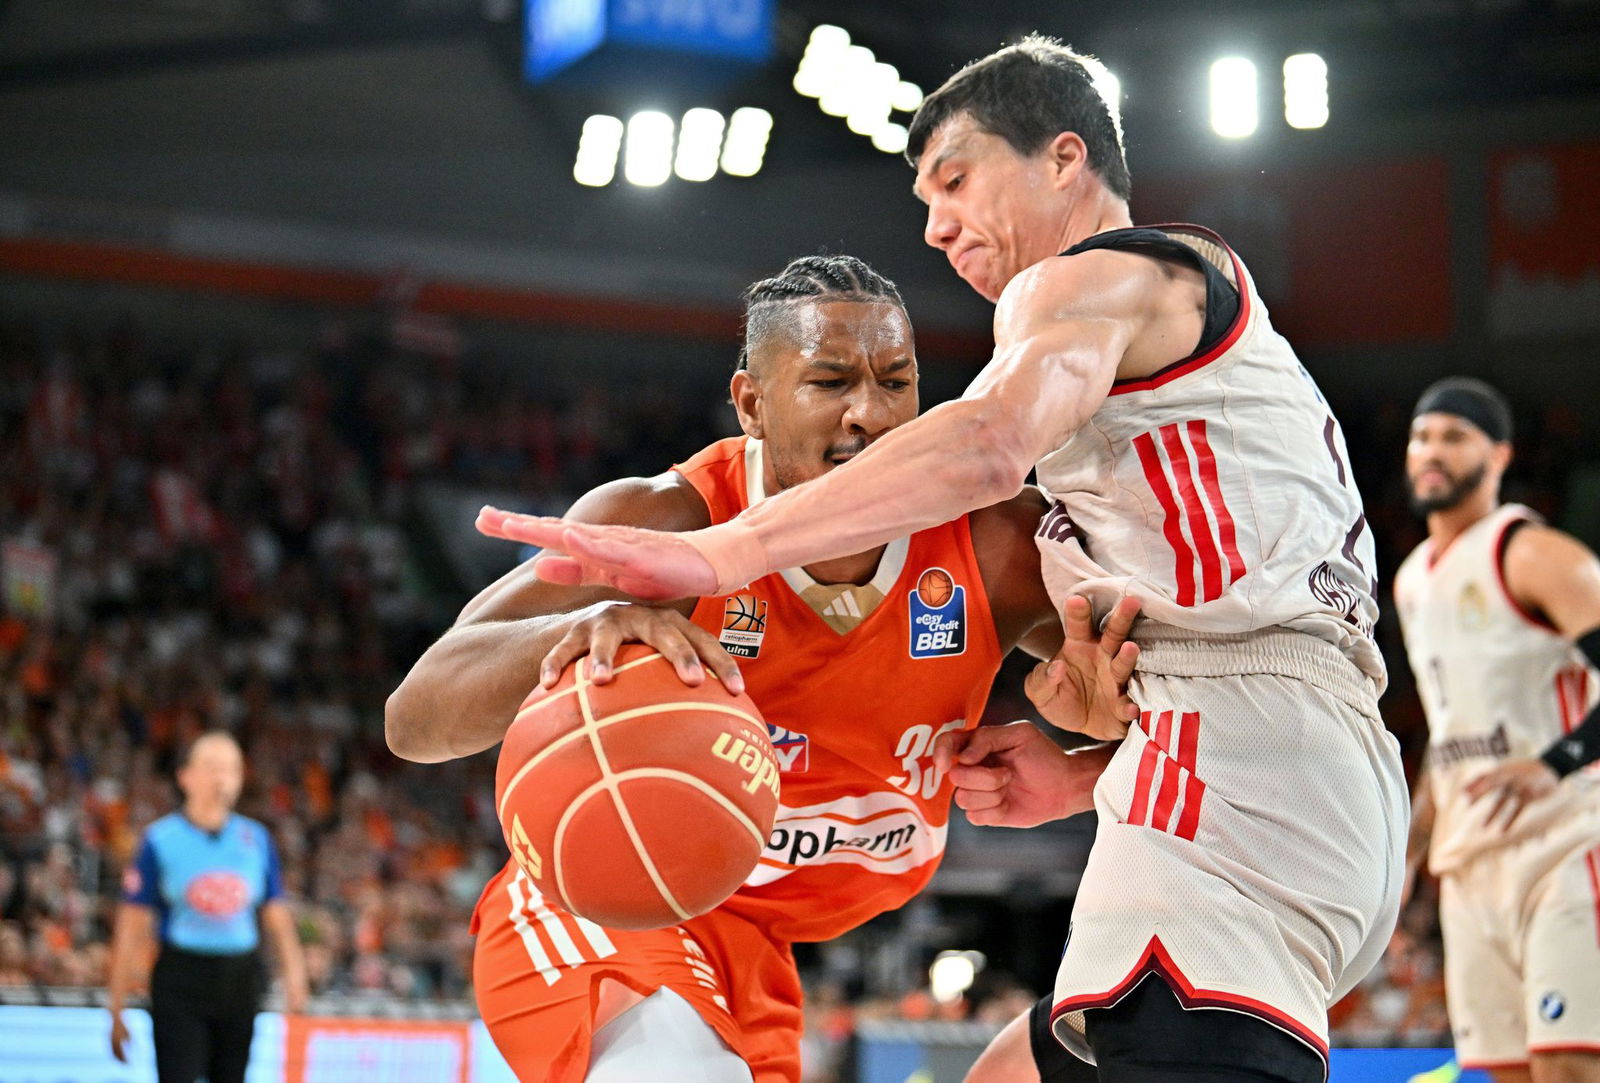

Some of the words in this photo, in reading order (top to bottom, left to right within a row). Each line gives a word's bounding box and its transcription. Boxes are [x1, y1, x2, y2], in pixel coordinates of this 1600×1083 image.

[929, 619, 959, 632] Credit
[915, 631, 958, 651] BBL
[727, 645, 749, 656] ulm
[767, 823, 917, 866] opharm
